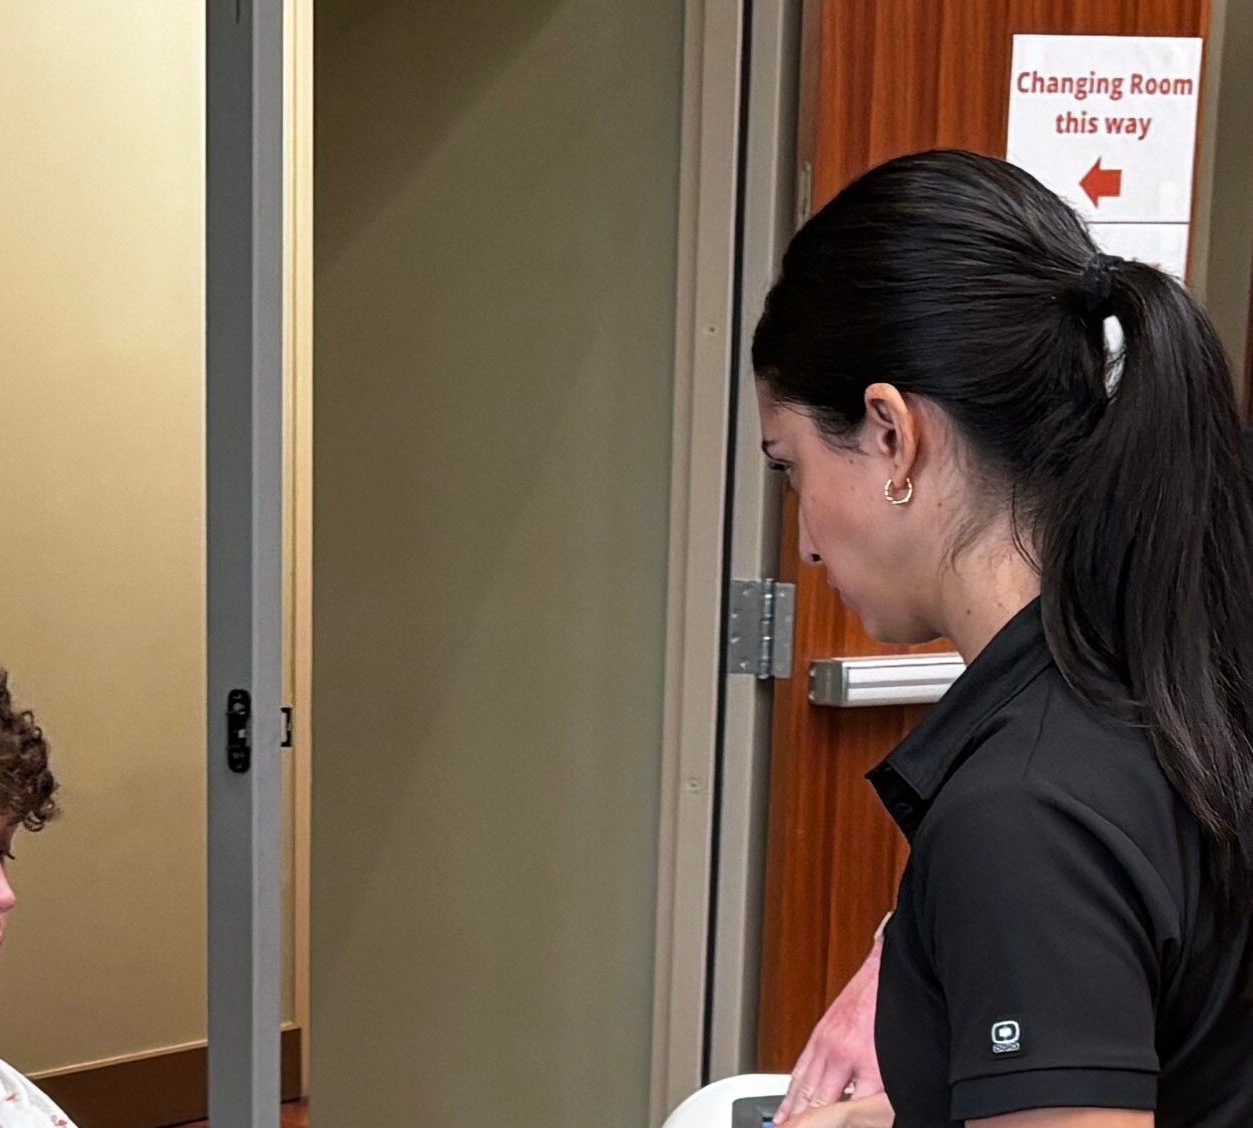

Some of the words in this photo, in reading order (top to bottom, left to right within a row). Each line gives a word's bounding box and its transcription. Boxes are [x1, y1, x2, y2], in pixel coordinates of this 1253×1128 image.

[1017, 71, 1124, 100] Changing
[1130, 74, 1193, 95] Room
[1056, 111, 1098, 134] this
[1105, 117, 1152, 140] way
